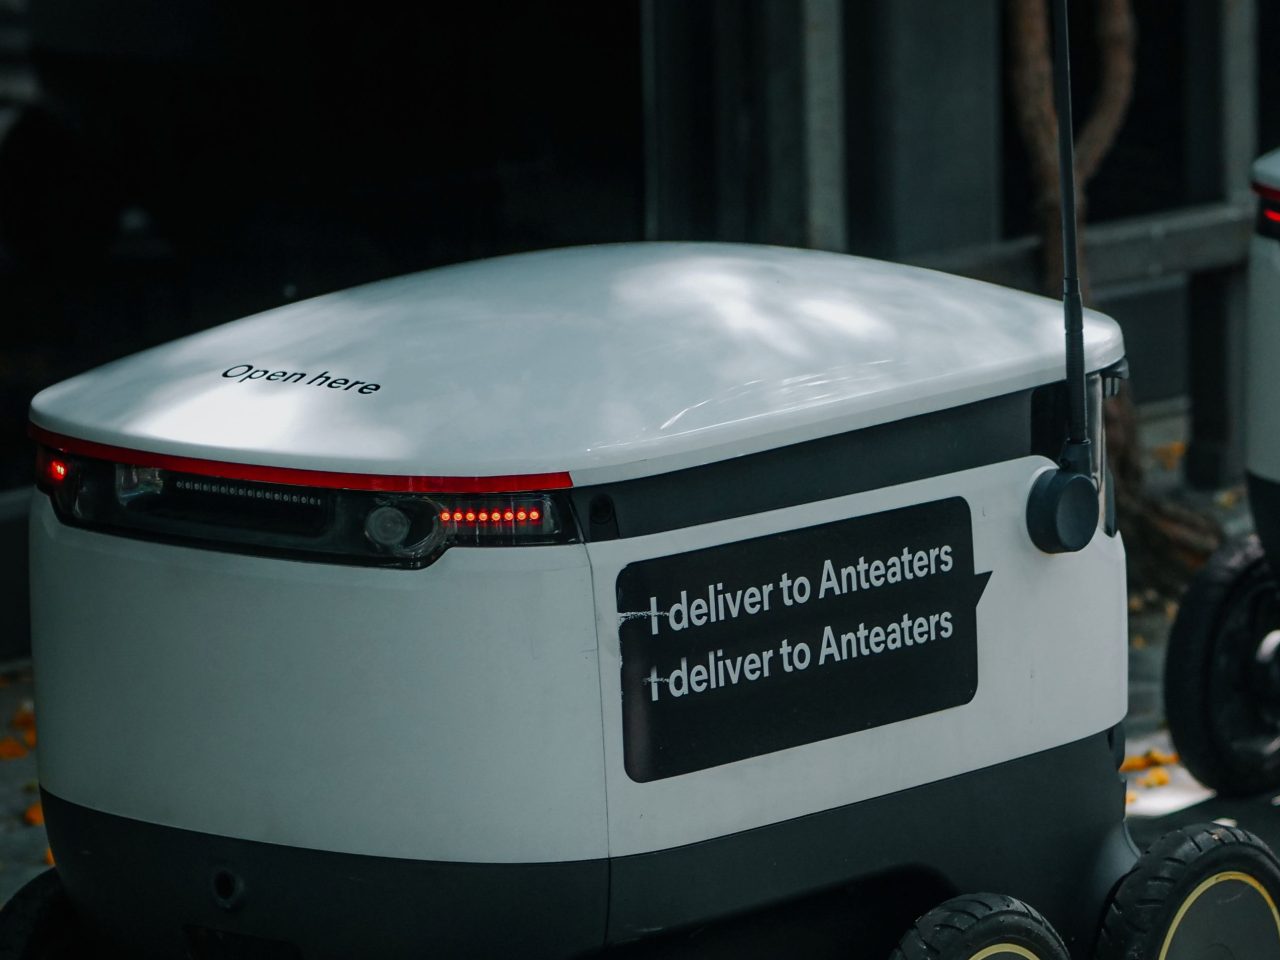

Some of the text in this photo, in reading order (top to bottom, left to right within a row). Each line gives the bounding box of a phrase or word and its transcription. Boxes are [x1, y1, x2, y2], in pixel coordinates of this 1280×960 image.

[221, 364, 381, 395] Open here
[650, 544, 954, 635] I deliver to Anteaters
[650, 611, 954, 701] I deliver to Anteaters
